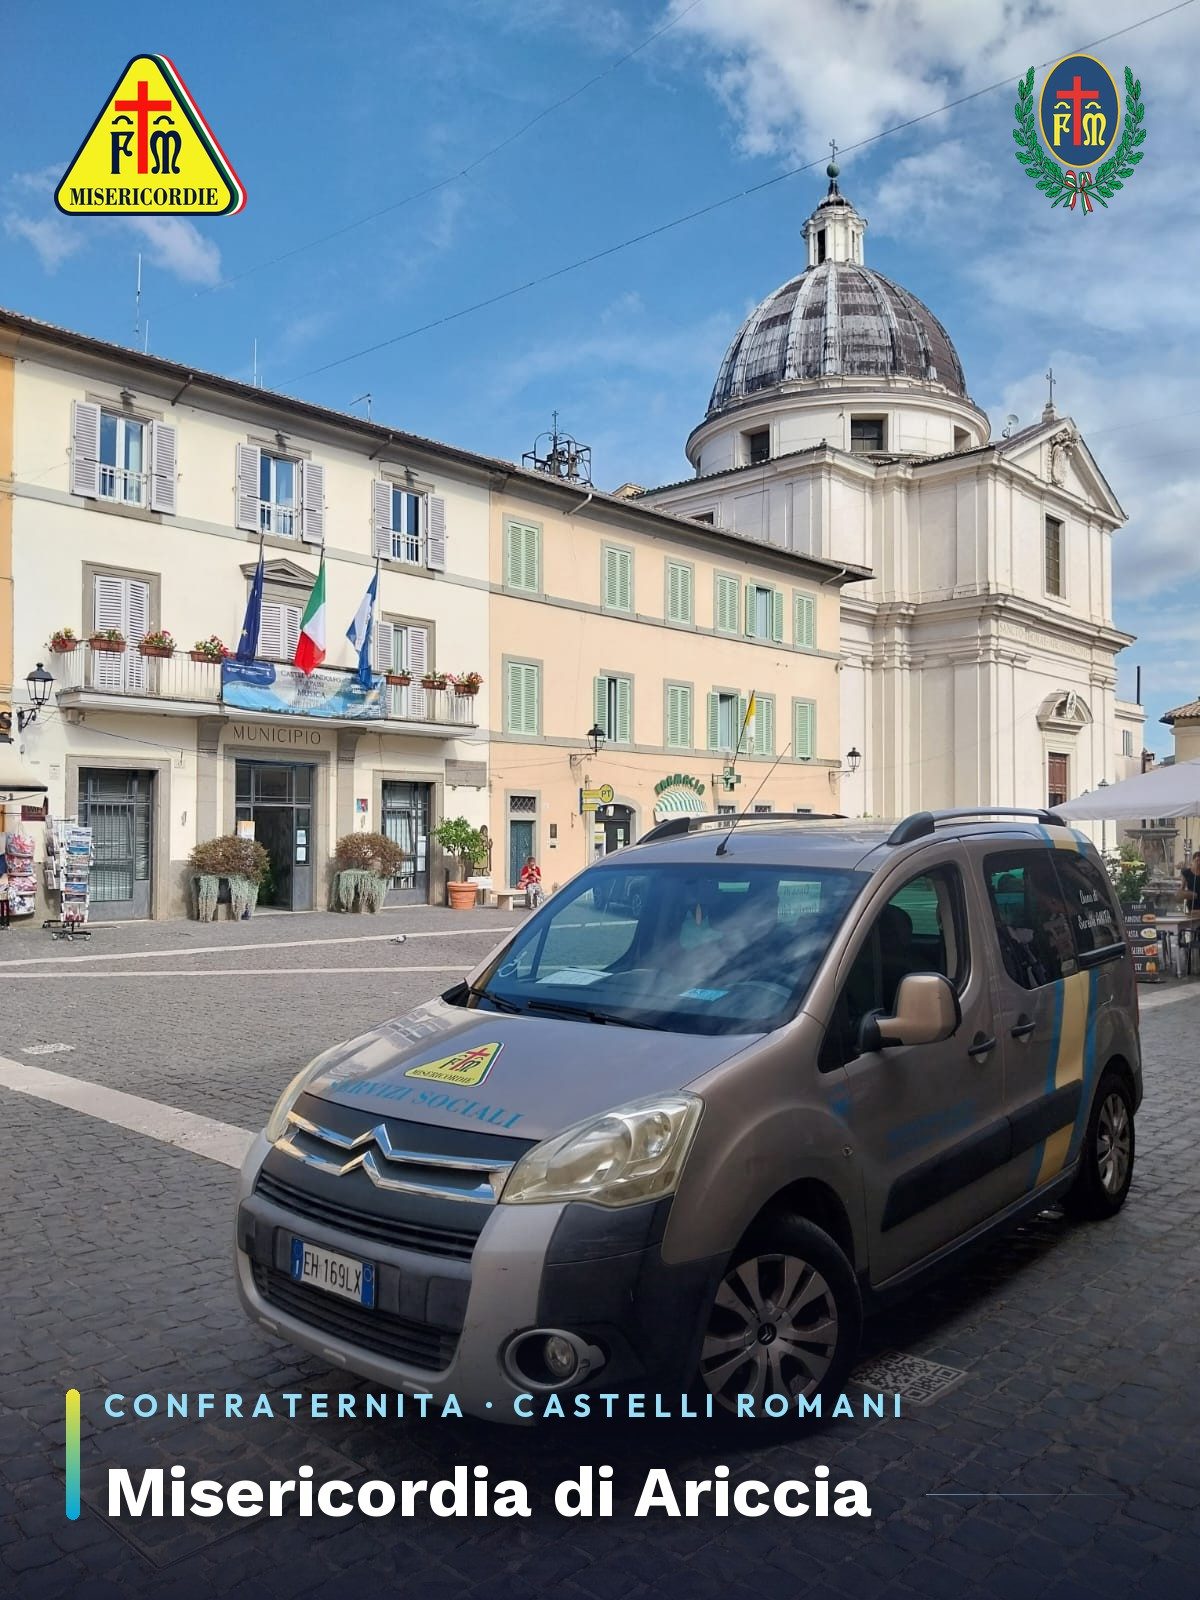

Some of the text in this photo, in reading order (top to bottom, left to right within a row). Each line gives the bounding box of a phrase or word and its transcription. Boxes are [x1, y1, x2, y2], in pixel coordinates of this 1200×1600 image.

[233, 725, 321, 745] MUNICIPIO
[601, 790, 612, 798] PT
[412, 1069, 476, 1083] MISERICORDIE
[411, 1091, 525, 1129] SOCIALI
[303, 1250, 319, 1279] EH
